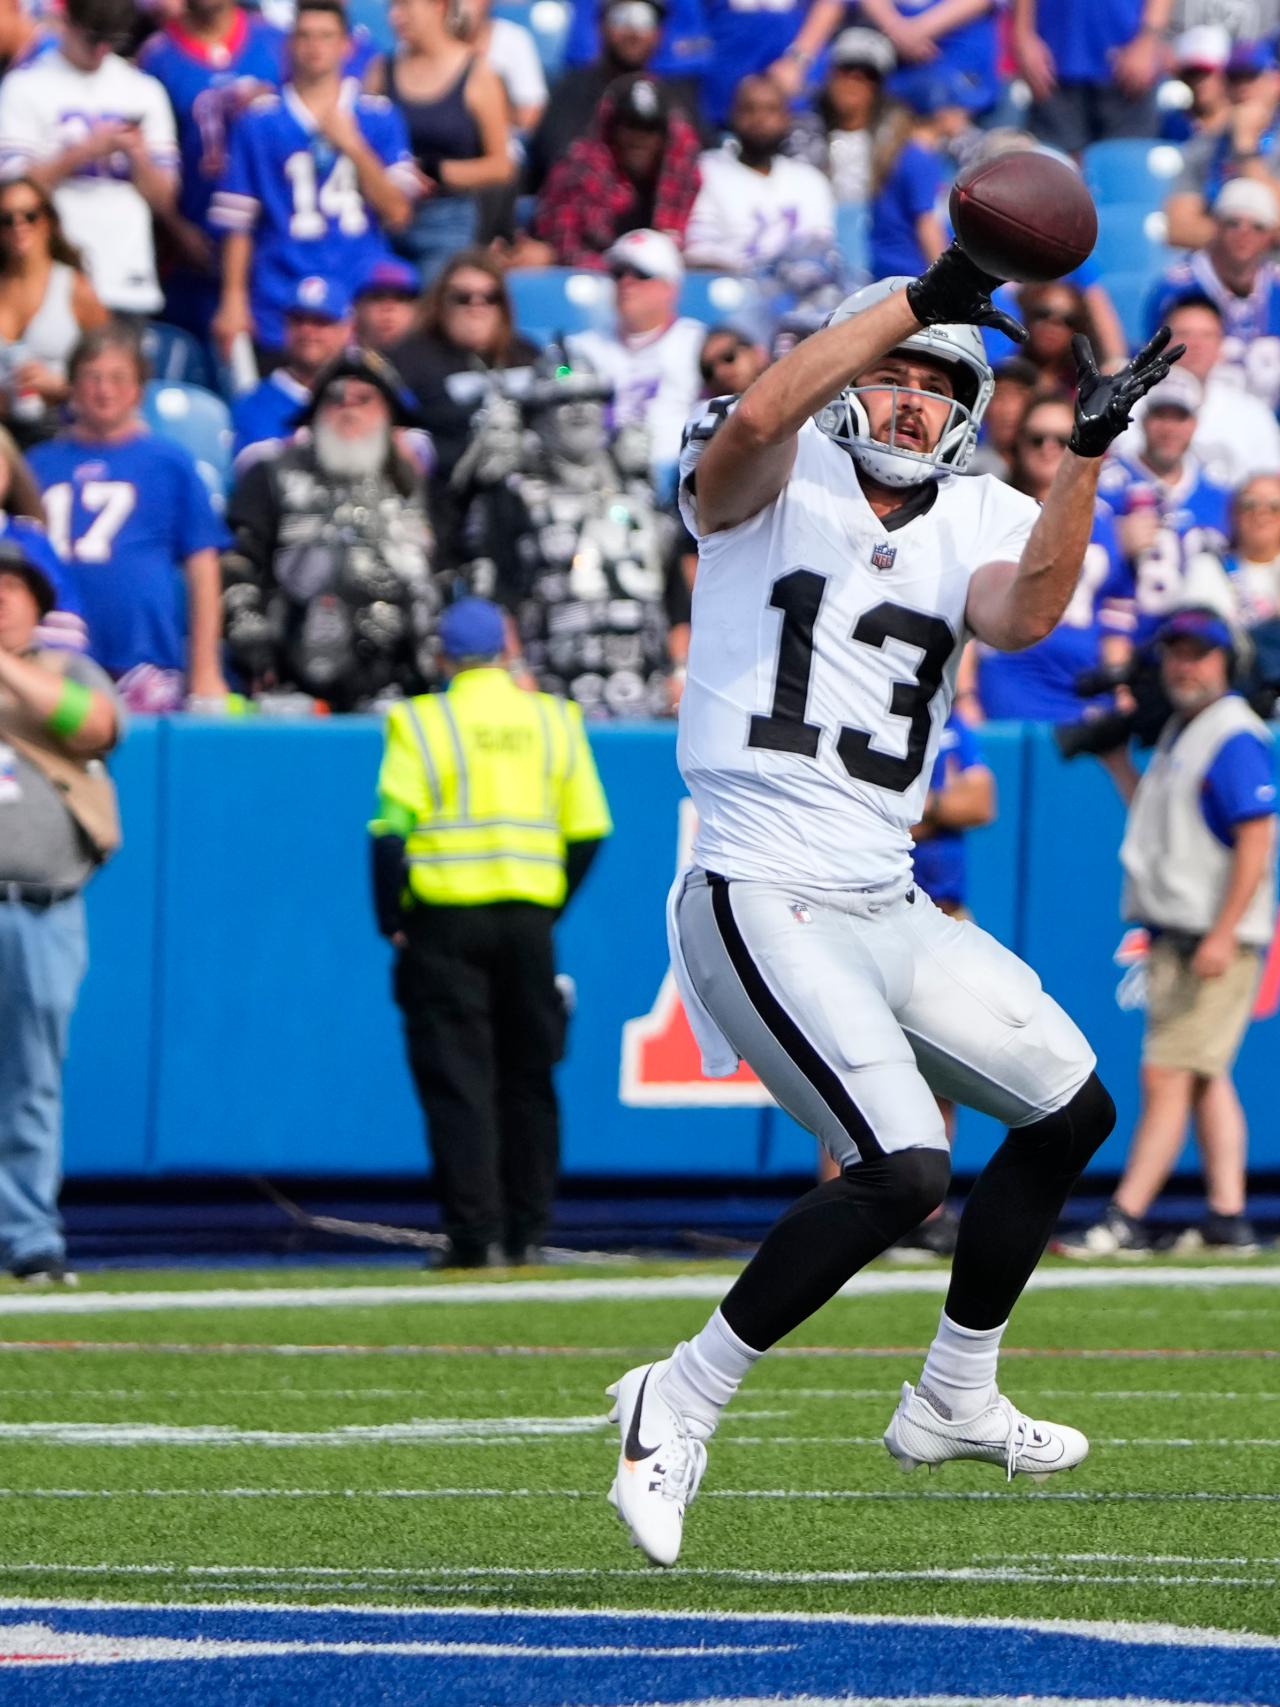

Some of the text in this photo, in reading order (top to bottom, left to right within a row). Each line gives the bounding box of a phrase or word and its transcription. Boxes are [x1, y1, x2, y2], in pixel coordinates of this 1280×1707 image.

[284, 150, 368, 239] 14
[41, 481, 137, 564] 17
[744, 565, 957, 796] 13
